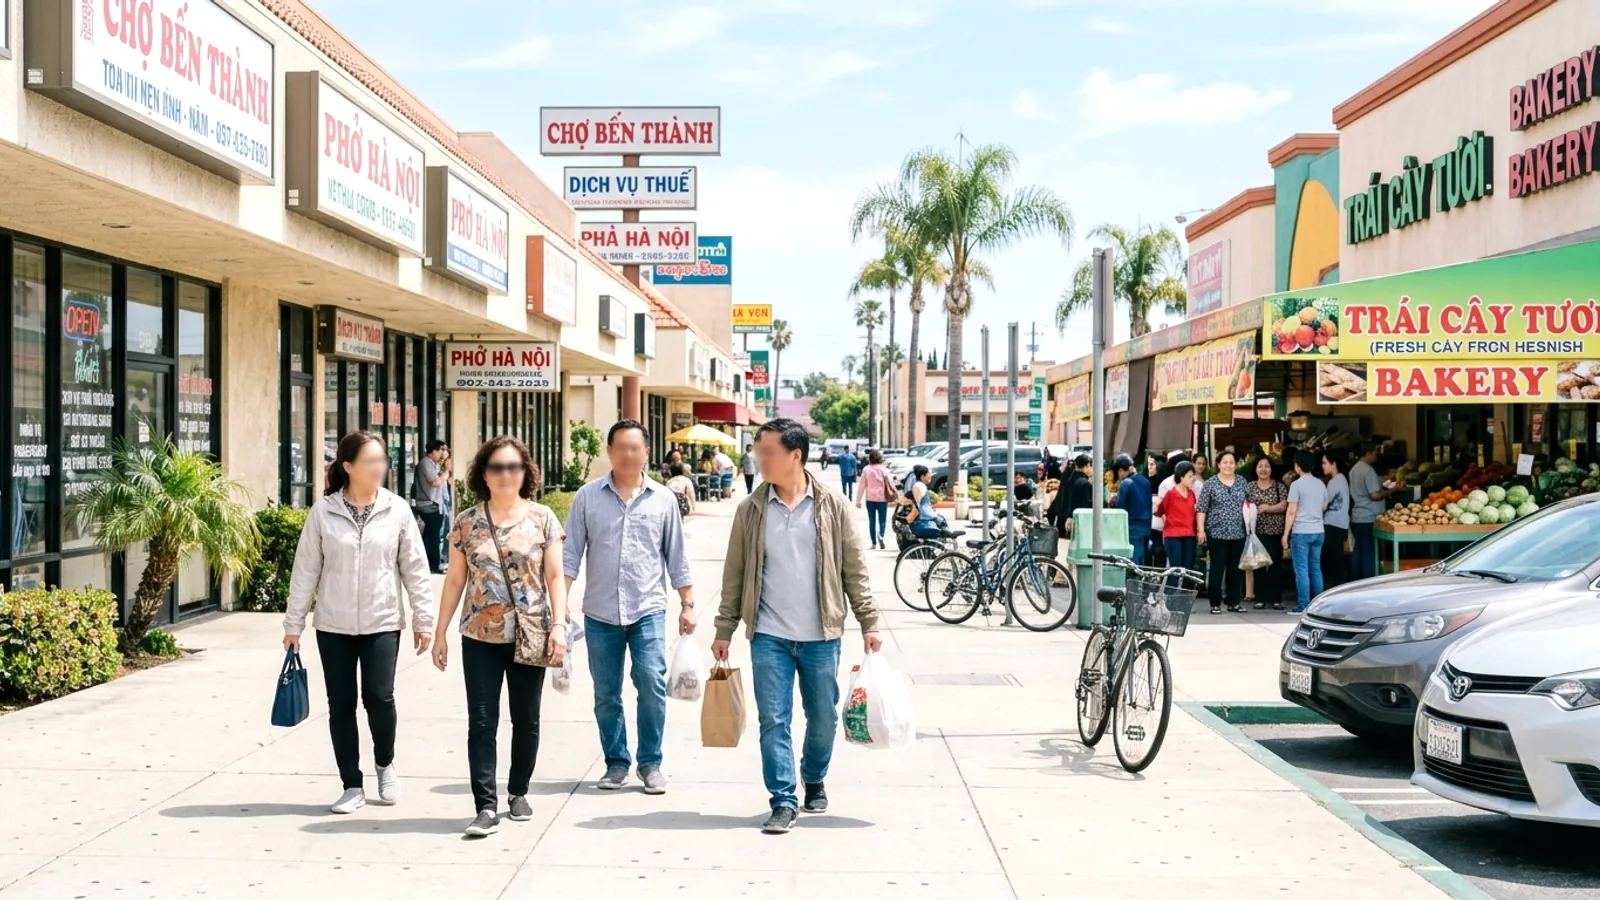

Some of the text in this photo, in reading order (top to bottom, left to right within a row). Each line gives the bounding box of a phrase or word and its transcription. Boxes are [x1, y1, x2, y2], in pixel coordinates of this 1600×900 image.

[160, 2, 202, 86] BẾN
[207, 44, 268, 125] THÀNH
[1509, 45, 1598, 131] BAKERY
[547, 111, 713, 150] CHỢ BẾN THÀNH
[324, 112, 363, 174] PHỞ
[367, 136, 391, 192] HÀ
[395, 154, 420, 215] NỘI
[1508, 121, 1598, 199] BAKERY
[569, 176, 609, 197] DỊCH
[616, 176, 638, 196] VỤ
[1344, 173, 1384, 244] TRÁI
[1388, 156, 1428, 229] CÂY
[658, 226, 690, 250] NỘI
[66, 306, 99, 337] OPEN
[1345, 296, 1431, 334] TRÁI
[1440, 296, 1513, 334] CÂY
[451, 344, 551, 370] PHỞ HÀ NỘI
[1370, 341, 1427, 355] (FRESH
[1515, 341, 1583, 353] HESNISH
[1375, 366, 1549, 397] BAKERY
